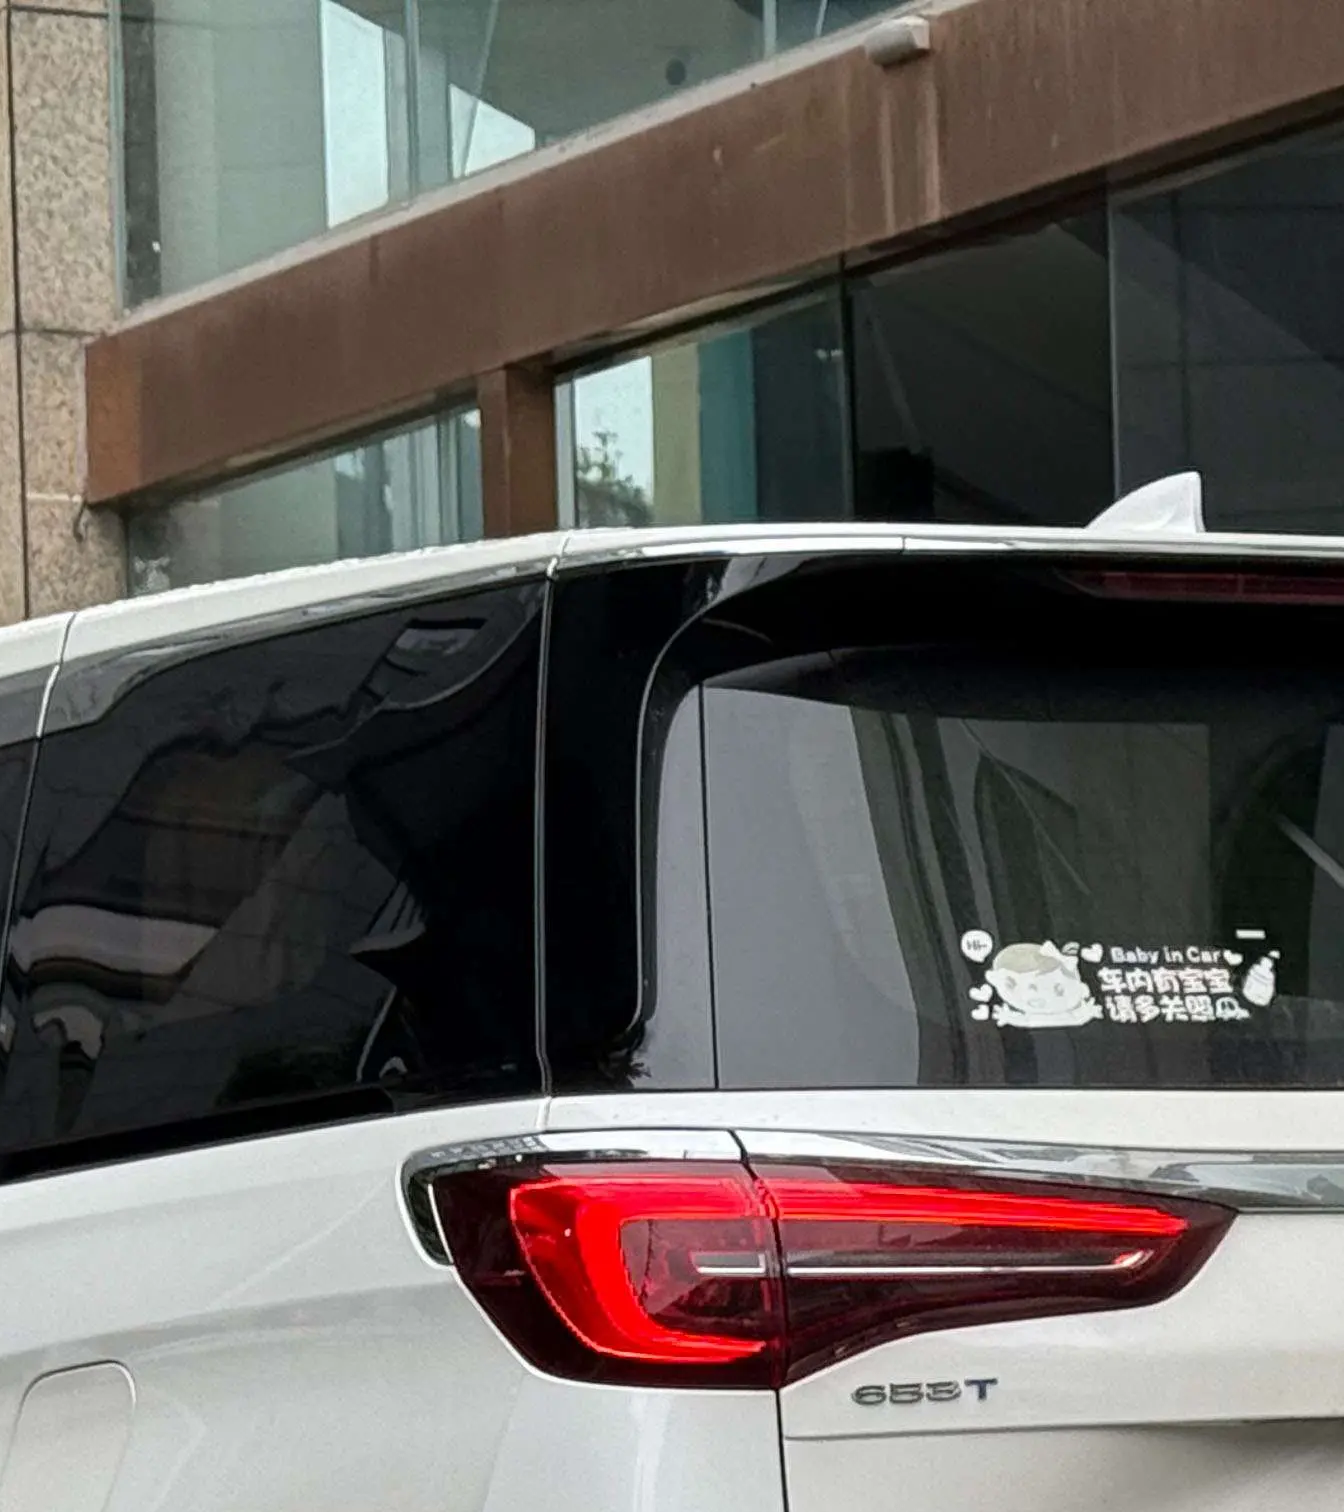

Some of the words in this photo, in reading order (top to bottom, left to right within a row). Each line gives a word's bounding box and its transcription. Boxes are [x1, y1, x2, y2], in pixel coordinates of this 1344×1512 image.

[1111, 946, 1159, 964] Baby
[1186, 946, 1221, 963] Car
[1097, 966, 1233, 994] 车内有宝宝
[1105, 995, 1216, 1023] 请多关照
[851, 1377, 998, 1406] 653T
